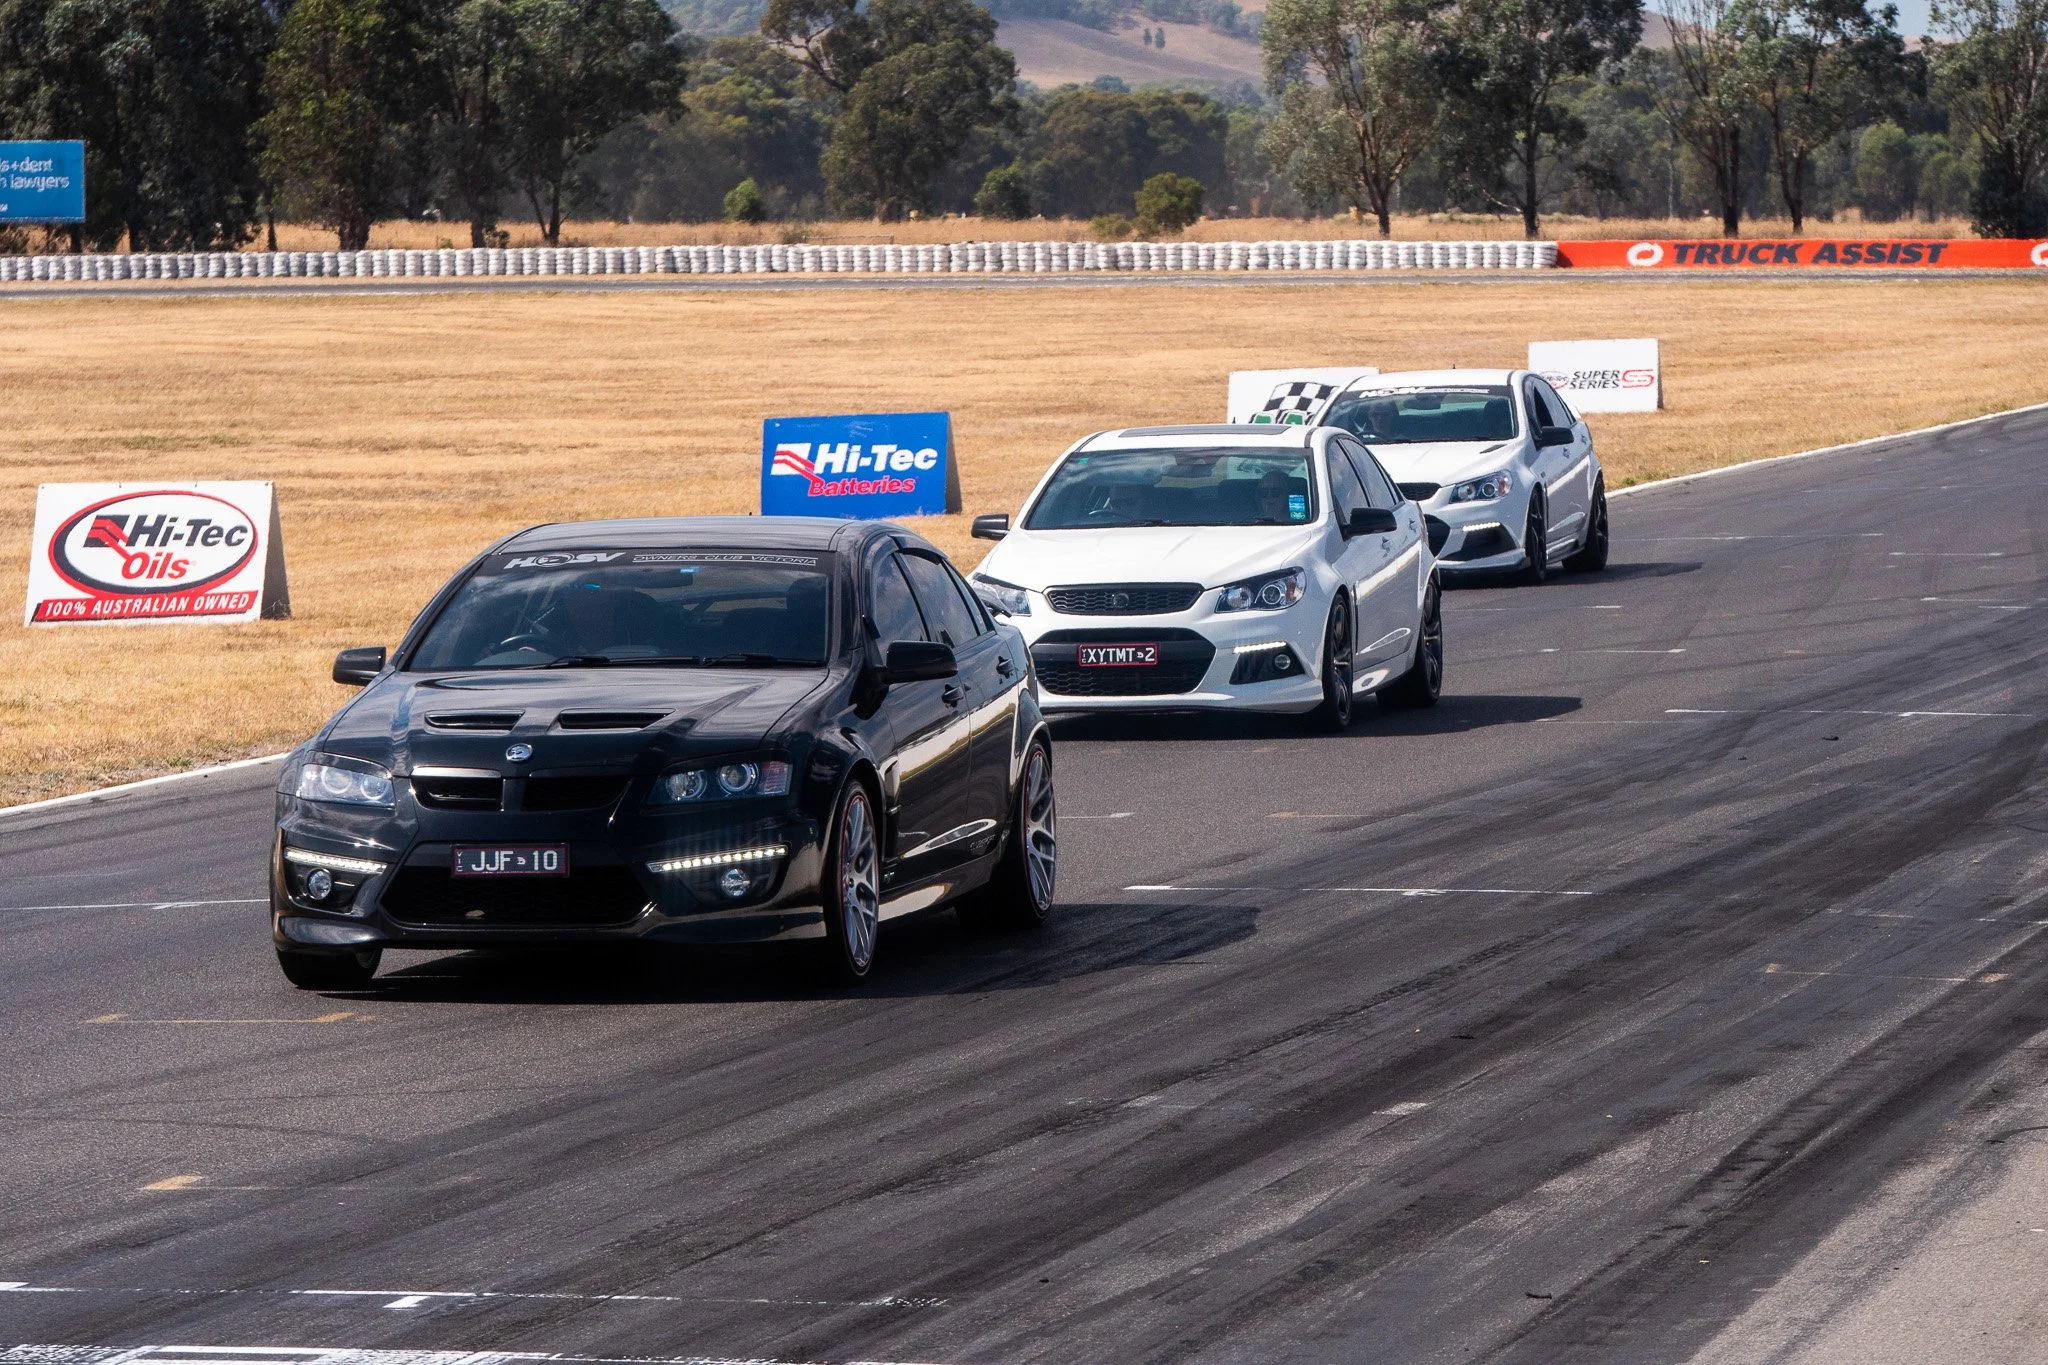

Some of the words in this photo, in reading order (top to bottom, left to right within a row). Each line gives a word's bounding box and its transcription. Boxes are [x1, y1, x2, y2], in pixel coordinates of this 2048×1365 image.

[10, 174, 70, 192] lawyers
[1673, 243, 1803, 264] TRUCK
[1811, 243, 1948, 265] ASSIST
[1569, 379, 1620, 389] SERIES
[1573, 370, 1620, 380] SUPER
[813, 442, 938, 474] Hi-Tec
[807, 475, 915, 497] Batteries
[125, 514, 248, 548] Hi-Tec
[121, 551, 190, 580] Oils
[751, 556, 817, 566] VICTORIA
[45, 600, 87, 617] 100%
[91, 595, 189, 615] AUSTRALIAN
[193, 593, 250, 611] OWNED
[1087, 648, 1136, 663] XYTMT
[471, 850, 514, 871] JJF
[532, 850, 558, 871] 10
